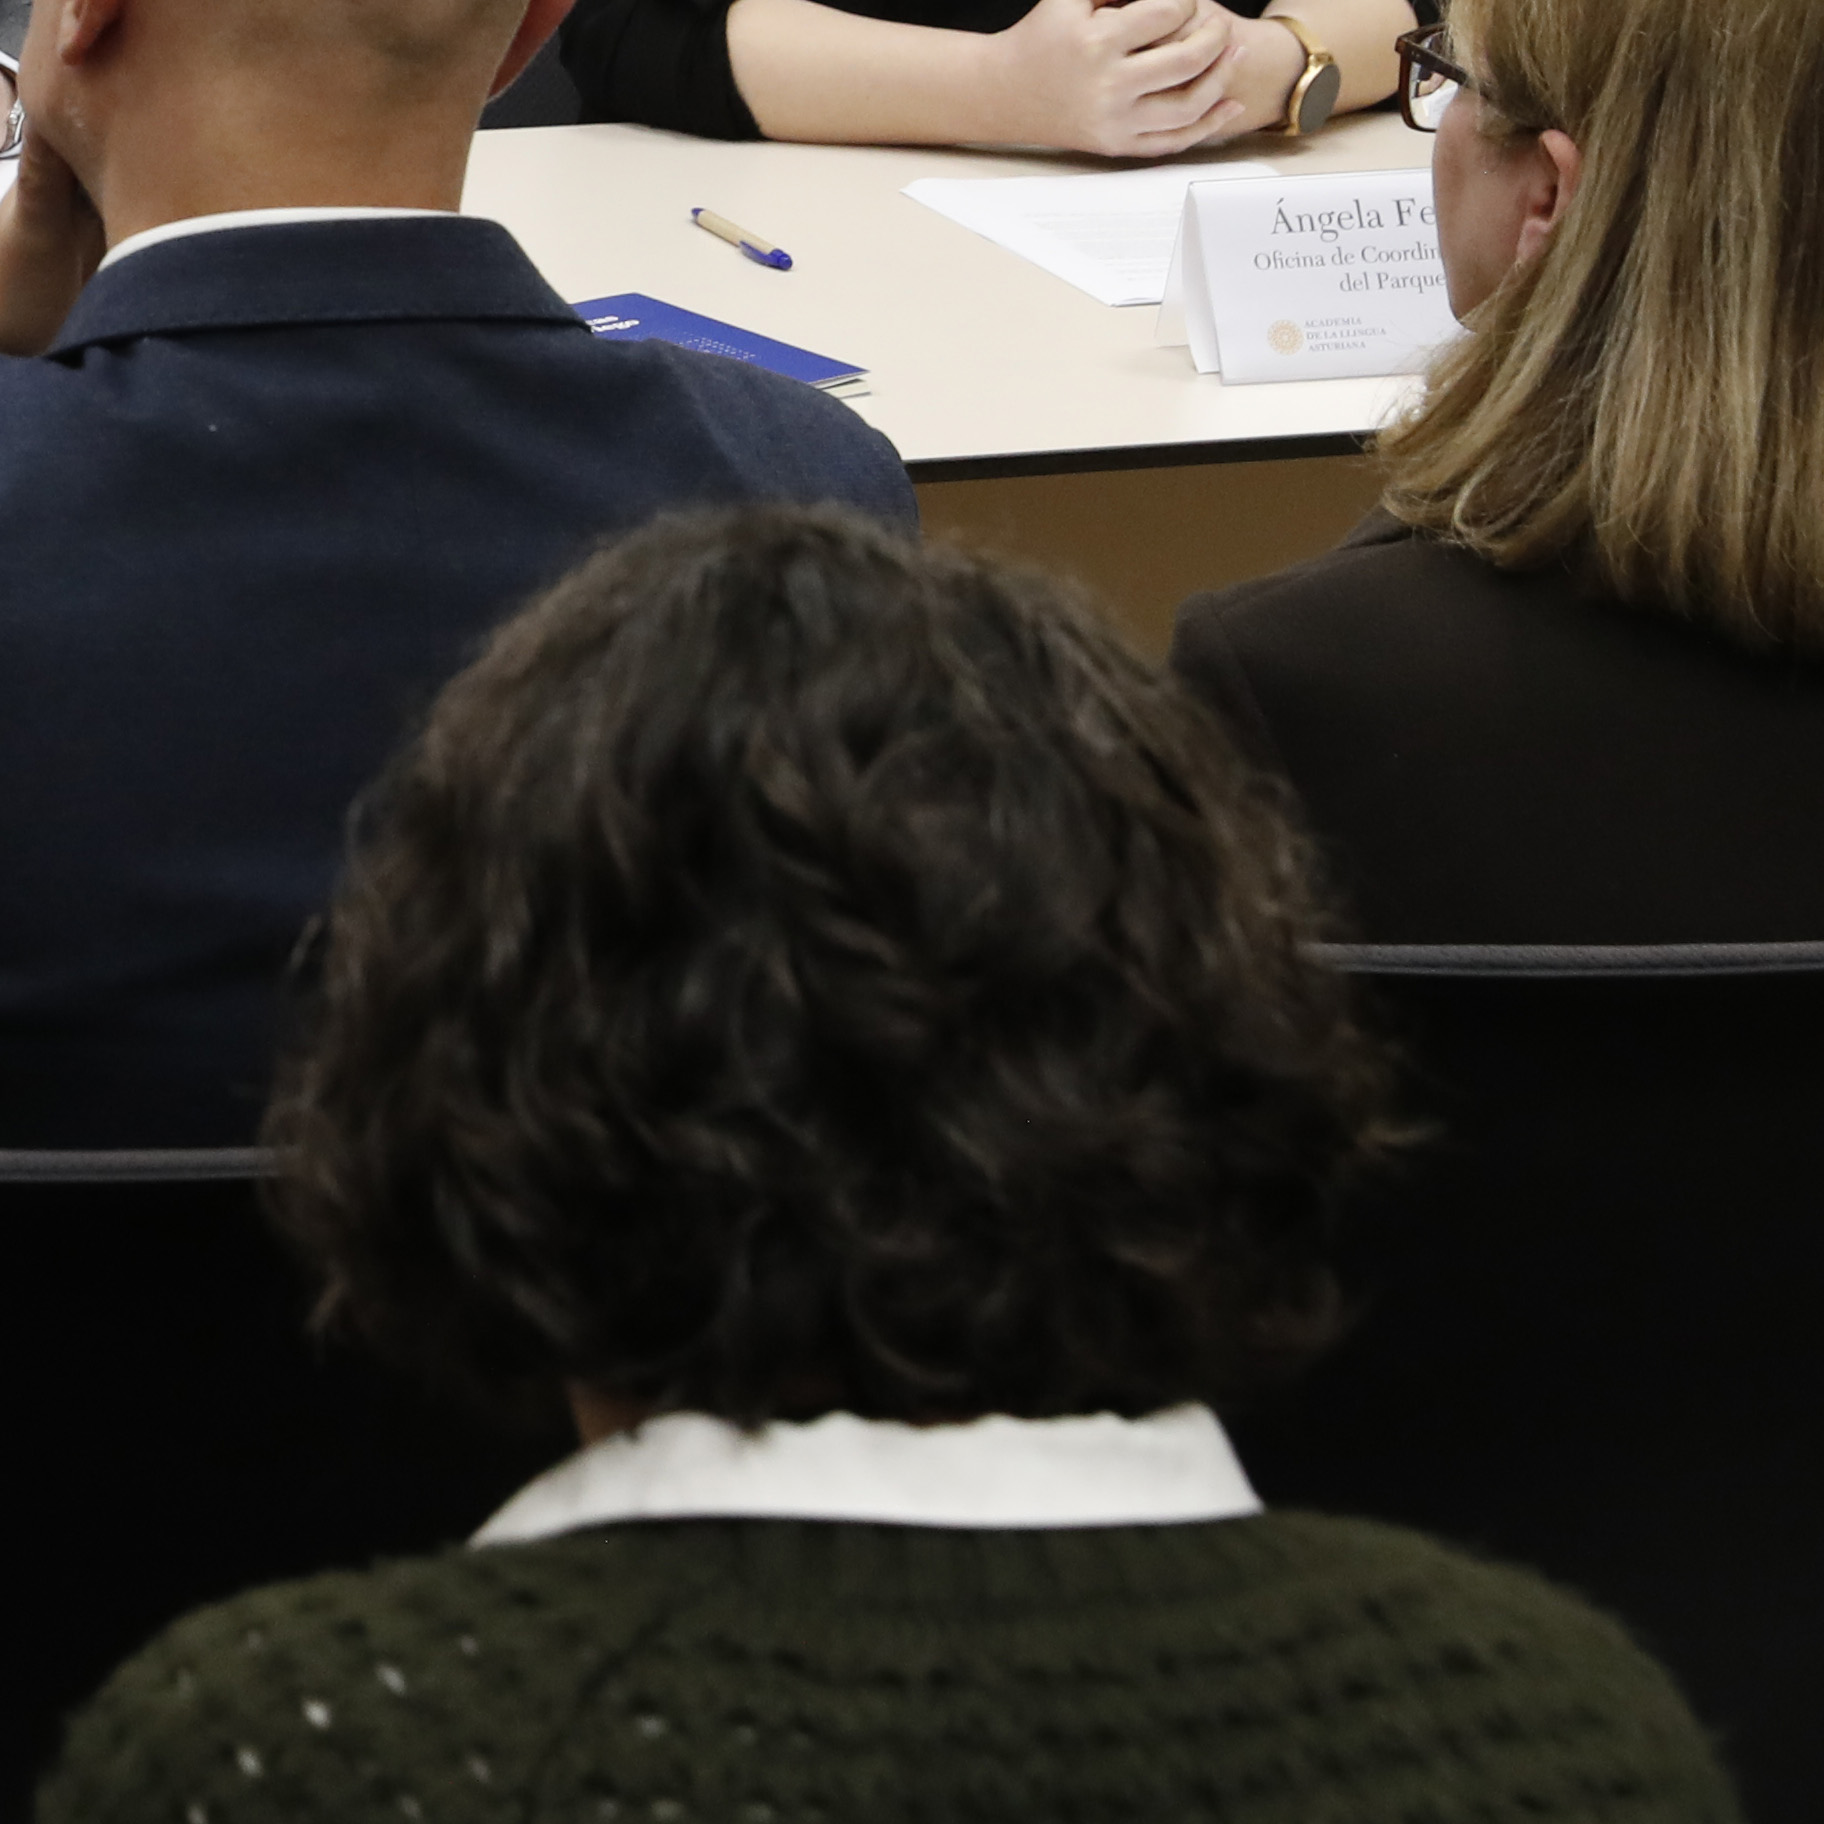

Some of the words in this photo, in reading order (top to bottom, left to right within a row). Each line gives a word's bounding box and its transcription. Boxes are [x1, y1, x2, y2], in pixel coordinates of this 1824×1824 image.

[1270, 197, 1385, 243] Ángela
[1254, 249, 1326, 271] Oficina
[1331, 246, 1356, 266] de
[1339, 271, 1370, 293] del
[1376, 271, 1447, 294] Parque
[1304, 316, 1363, 329] ACADEMIA
[1306, 330, 1323, 341] DE
[1340, 327, 1387, 339] LLINGUA
[1308, 340, 1366, 353] ASTURIANA
